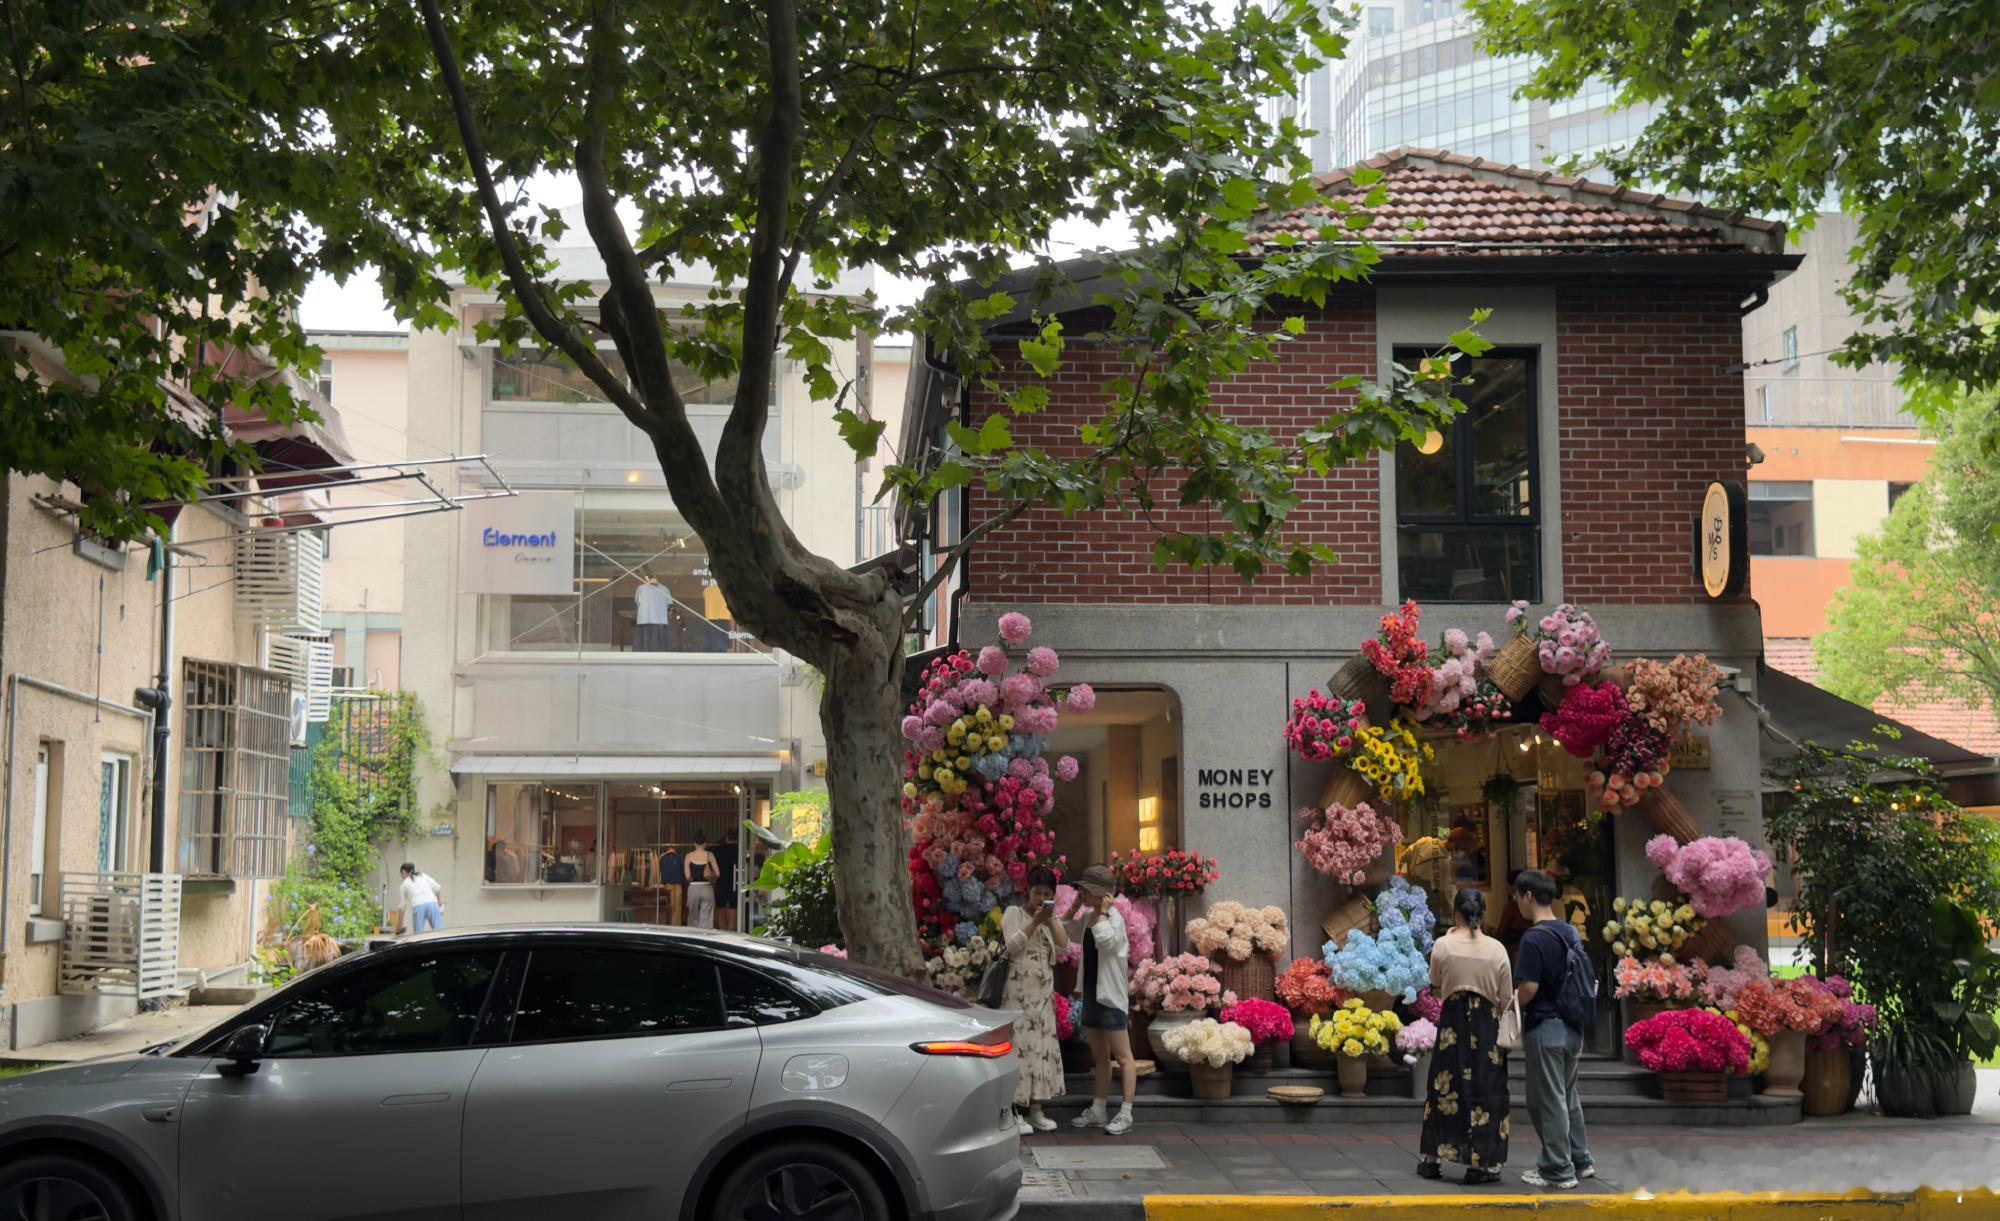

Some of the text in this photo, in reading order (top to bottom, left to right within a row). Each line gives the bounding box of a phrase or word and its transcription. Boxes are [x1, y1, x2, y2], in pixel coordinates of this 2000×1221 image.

[693, 568, 708, 576] and
[701, 578, 709, 586] in
[1198, 768, 1274, 786] MONEY
[1199, 792, 1271, 808] SHOPS
